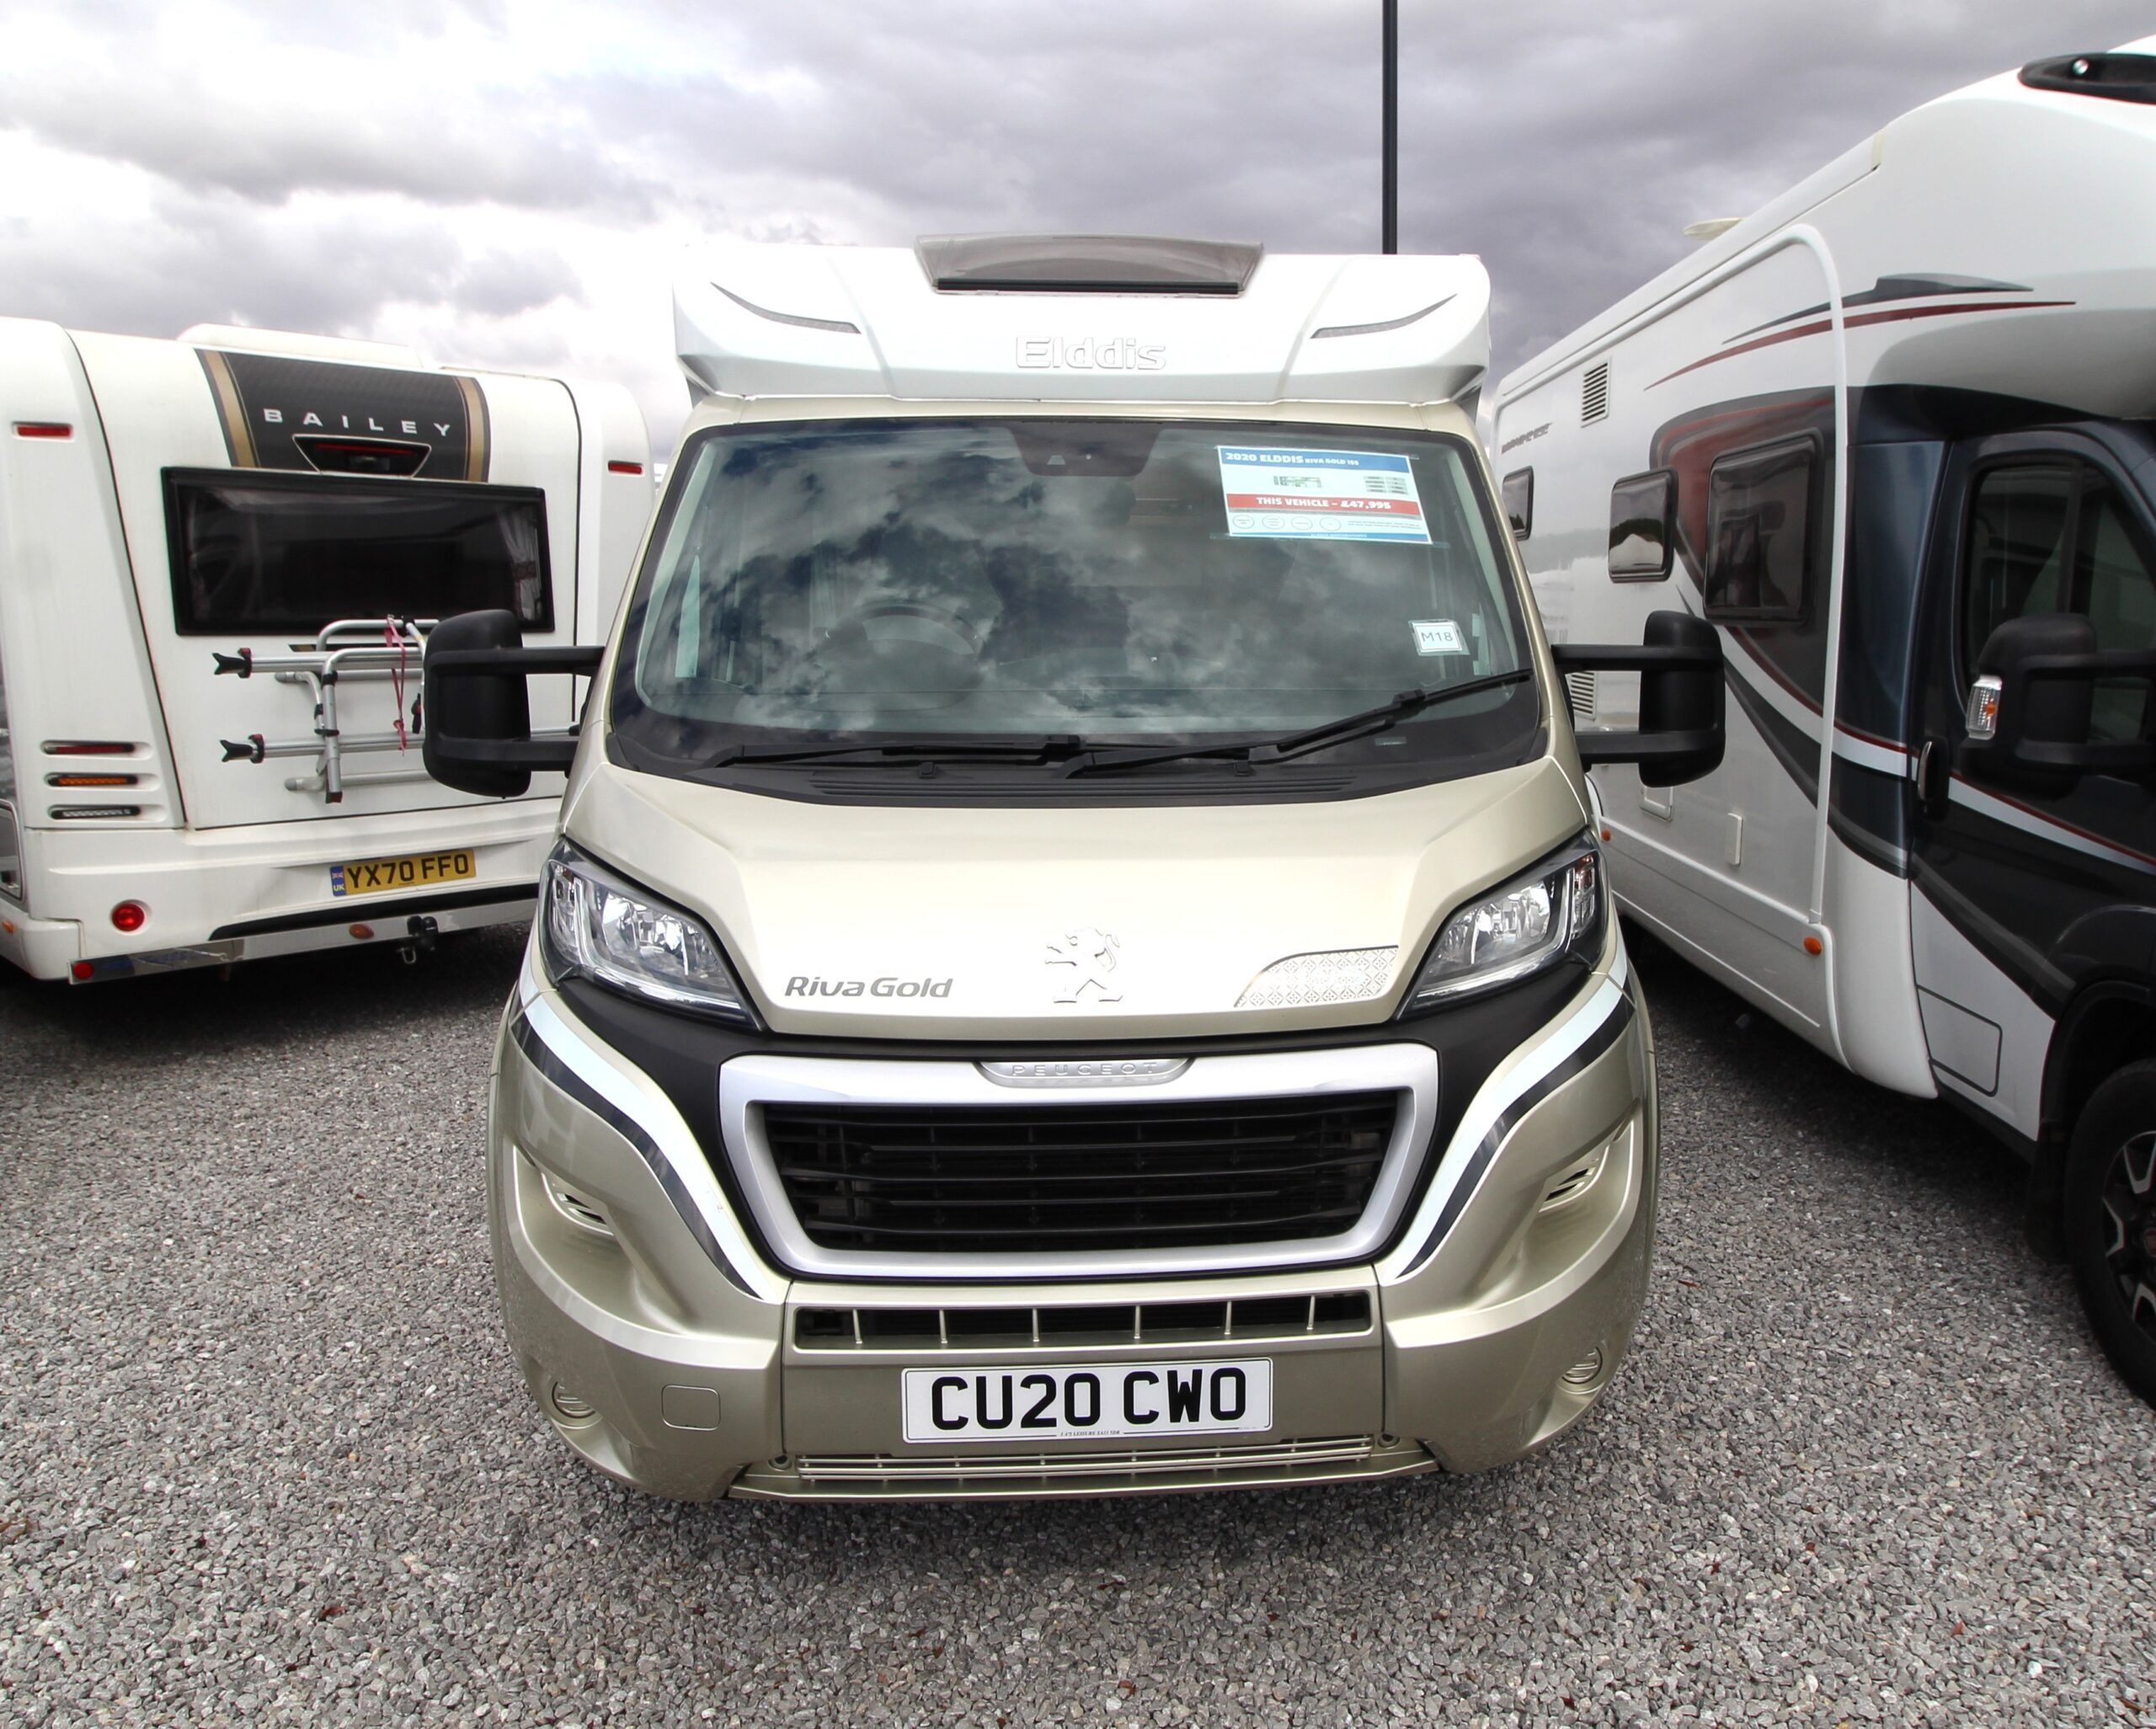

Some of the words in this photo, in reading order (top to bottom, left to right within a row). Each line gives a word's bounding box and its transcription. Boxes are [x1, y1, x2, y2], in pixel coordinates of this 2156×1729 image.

[1016, 336, 1166, 371] Elddis
[263, 408, 451, 437] BAILEY
[1225, 451, 1257, 462] 2020
[1259, 454, 1305, 464] ELDDIS
[1256, 497, 1283, 506] THIS
[1285, 498, 1329, 507] VEHICLE
[1341, 500, 1392, 510] £47,995
[1421, 632, 1453, 642] M18
[347, 861, 414, 889] YX70
[421, 854, 469, 879] FFO
[332, 883, 345, 892] UK
[784, 976, 866, 997] Riva
[870, 977, 953, 998] Gold
[1011, 1061, 1157, 1076] PEUGEOT
[931, 1372, 1102, 1431] CU20
[1123, 1367, 1246, 1425] CWO
